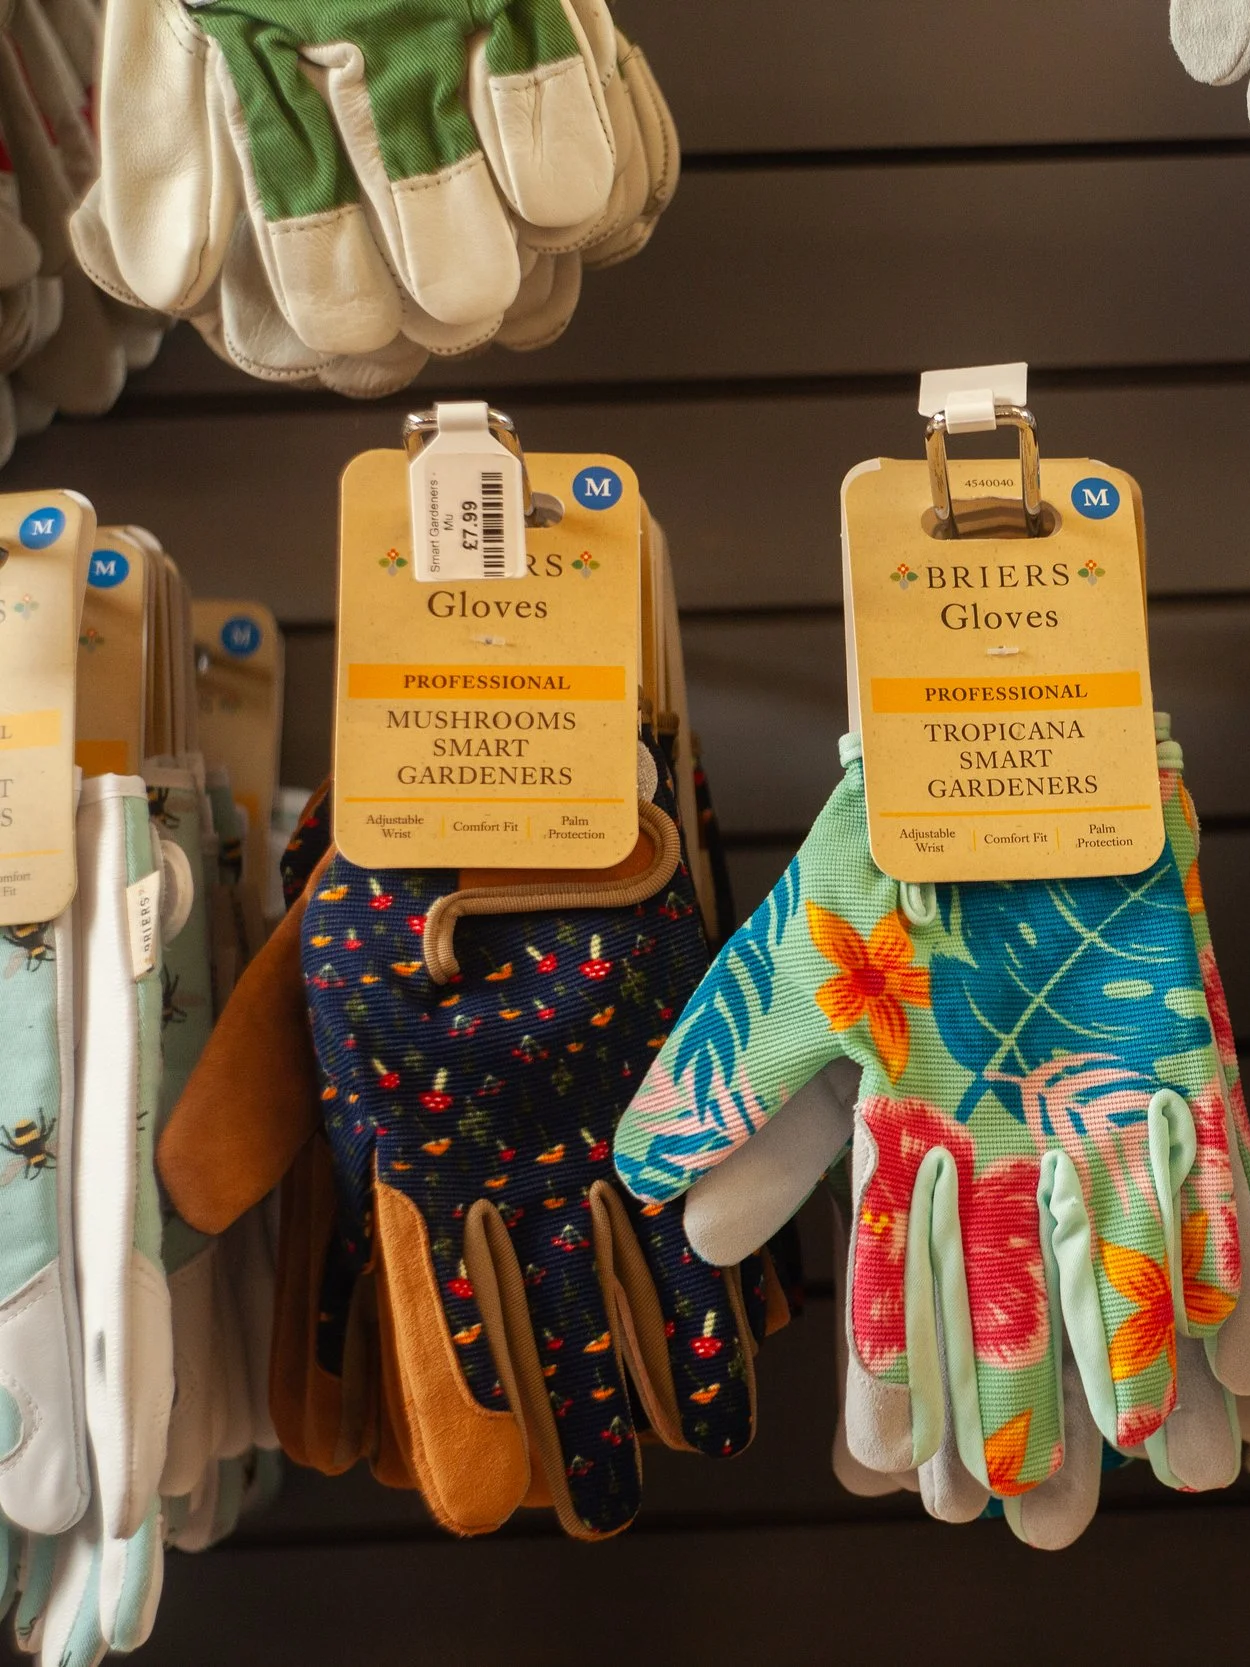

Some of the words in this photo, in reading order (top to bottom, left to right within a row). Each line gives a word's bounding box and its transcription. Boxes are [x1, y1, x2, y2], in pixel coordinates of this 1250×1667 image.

[585, 478, 613, 498] M
[964, 478, 1015, 489] 4540040
[1082, 489, 1110, 507] M
[429, 479, 440, 536] Gardeners
[31, 519, 53, 536] M
[444, 513, 454, 531] Mu
[461, 500, 478, 551] £7.99
[430, 536, 440, 573] Smart
[94, 560, 117, 576] M
[926, 562, 1071, 590] BRIERS
[426, 590, 549, 619] Gloves
[940, 602, 1060, 631] Gloves
[403, 674, 571, 692] PROFESSIONAL
[924, 684, 1088, 702] PROFESSIONAL
[386, 710, 577, 731] MUSHROOMS
[924, 719, 1085, 744] TROPICANA
[433, 738, 531, 758] SMART
[959, 748, 1053, 770] SMART
[397, 766, 574, 786] GARDENERS
[927, 775, 1099, 800] GARDENERS
[366, 814, 425, 827] Adjustable
[453, 820, 500, 833] Comfort
[503, 820, 519, 833] Fit
[561, 815, 589, 827] Palm
[1089, 823, 1116, 835] Palm
[381, 828, 412, 840] Wrist
[548, 828, 606, 841] Protection
[899, 827, 956, 842] Adjustable
[983, 832, 1029, 845] Comfort
[1033, 831, 1048, 844] Fit
[1078, 835, 1134, 849] Protection
[916, 842, 944, 854] Wrist
[0, 871, 31, 882] omfort
[3, 888, 16, 897] Fit
